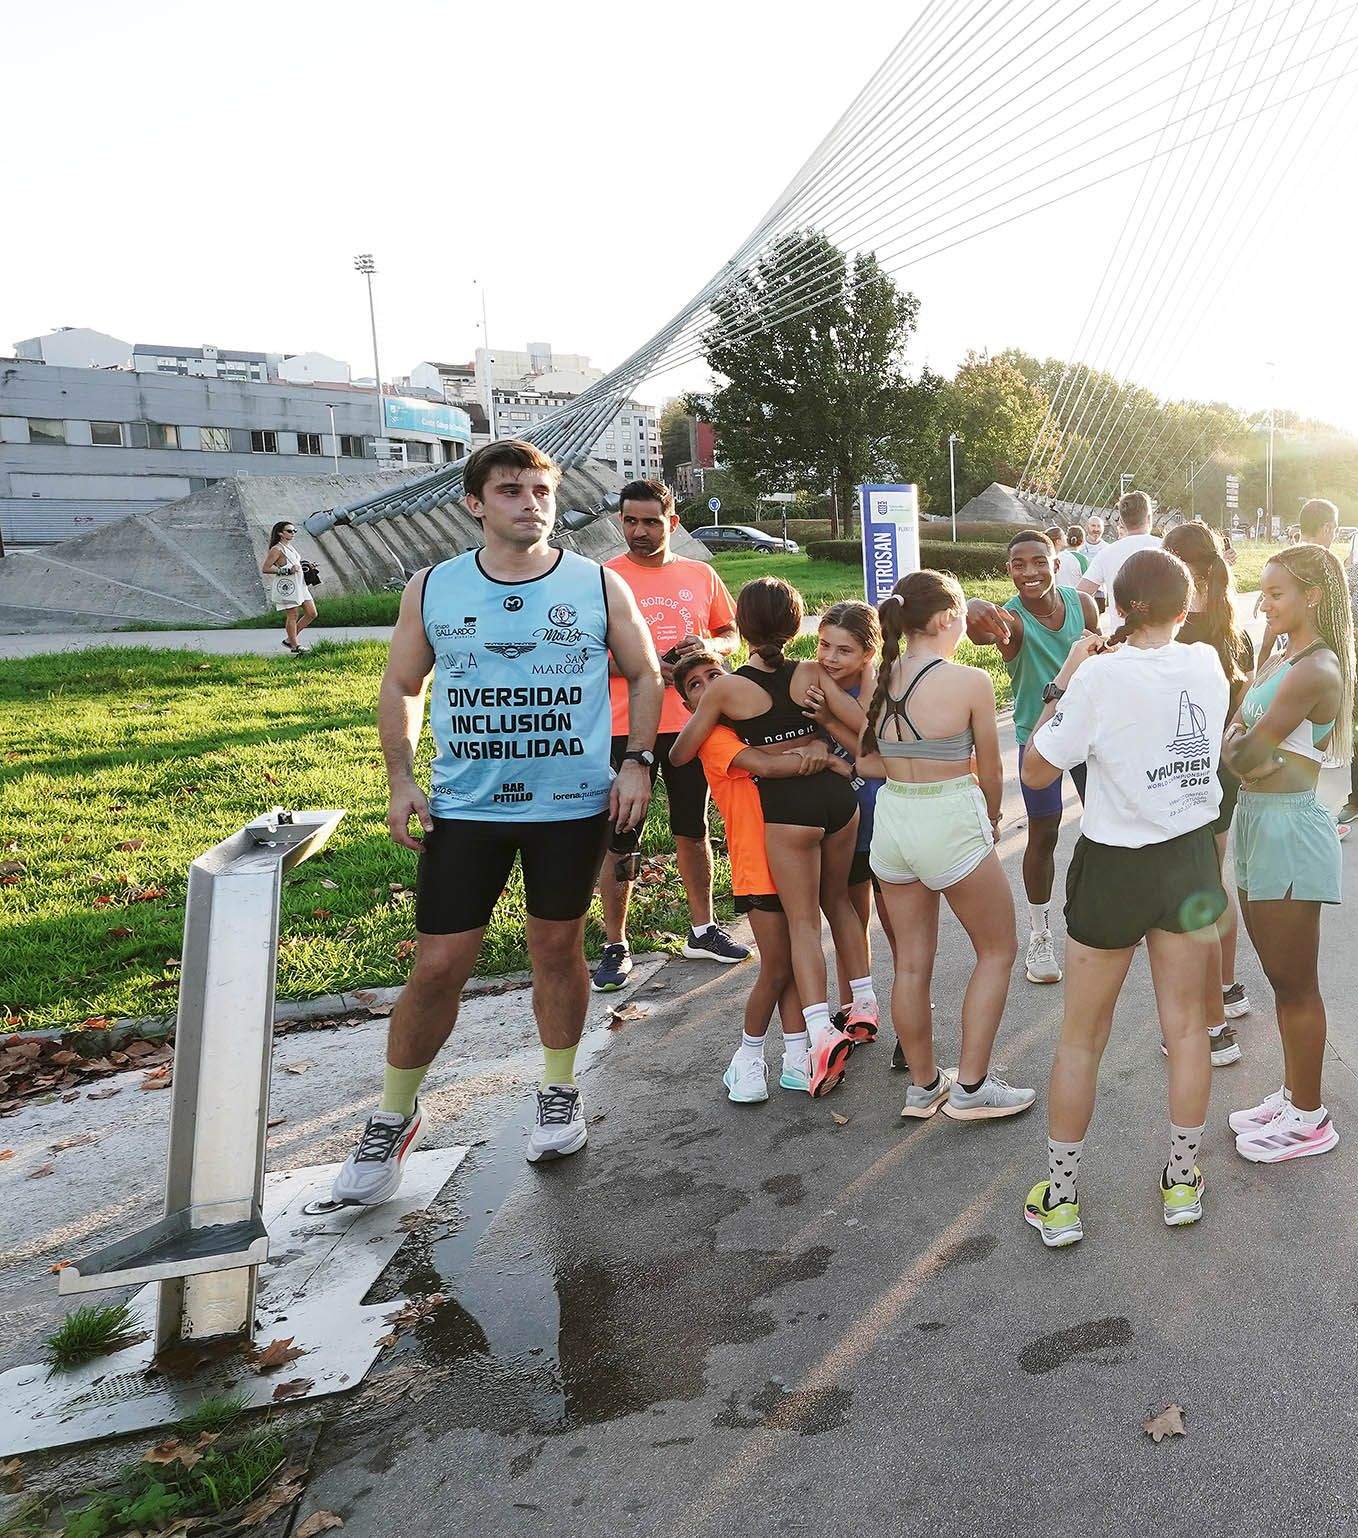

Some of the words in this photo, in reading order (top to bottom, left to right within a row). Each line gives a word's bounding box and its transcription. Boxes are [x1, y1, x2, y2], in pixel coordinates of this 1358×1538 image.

[436, 628, 476, 637] GALLARDO
[531, 664, 585, 675] MARCOS
[447, 686, 583, 708] DIVERSIDAD
[451, 709, 572, 735] INCLUSIÓN
[449, 737, 585, 760] VISIBILIDAD
[1146, 756, 1210, 783] VAURIEN
[502, 783, 525, 793] BAR
[1147, 780, 1169, 791] WORLD
[1180, 776, 1210, 788] 2016
[493, 792, 533, 804] PITILLO
